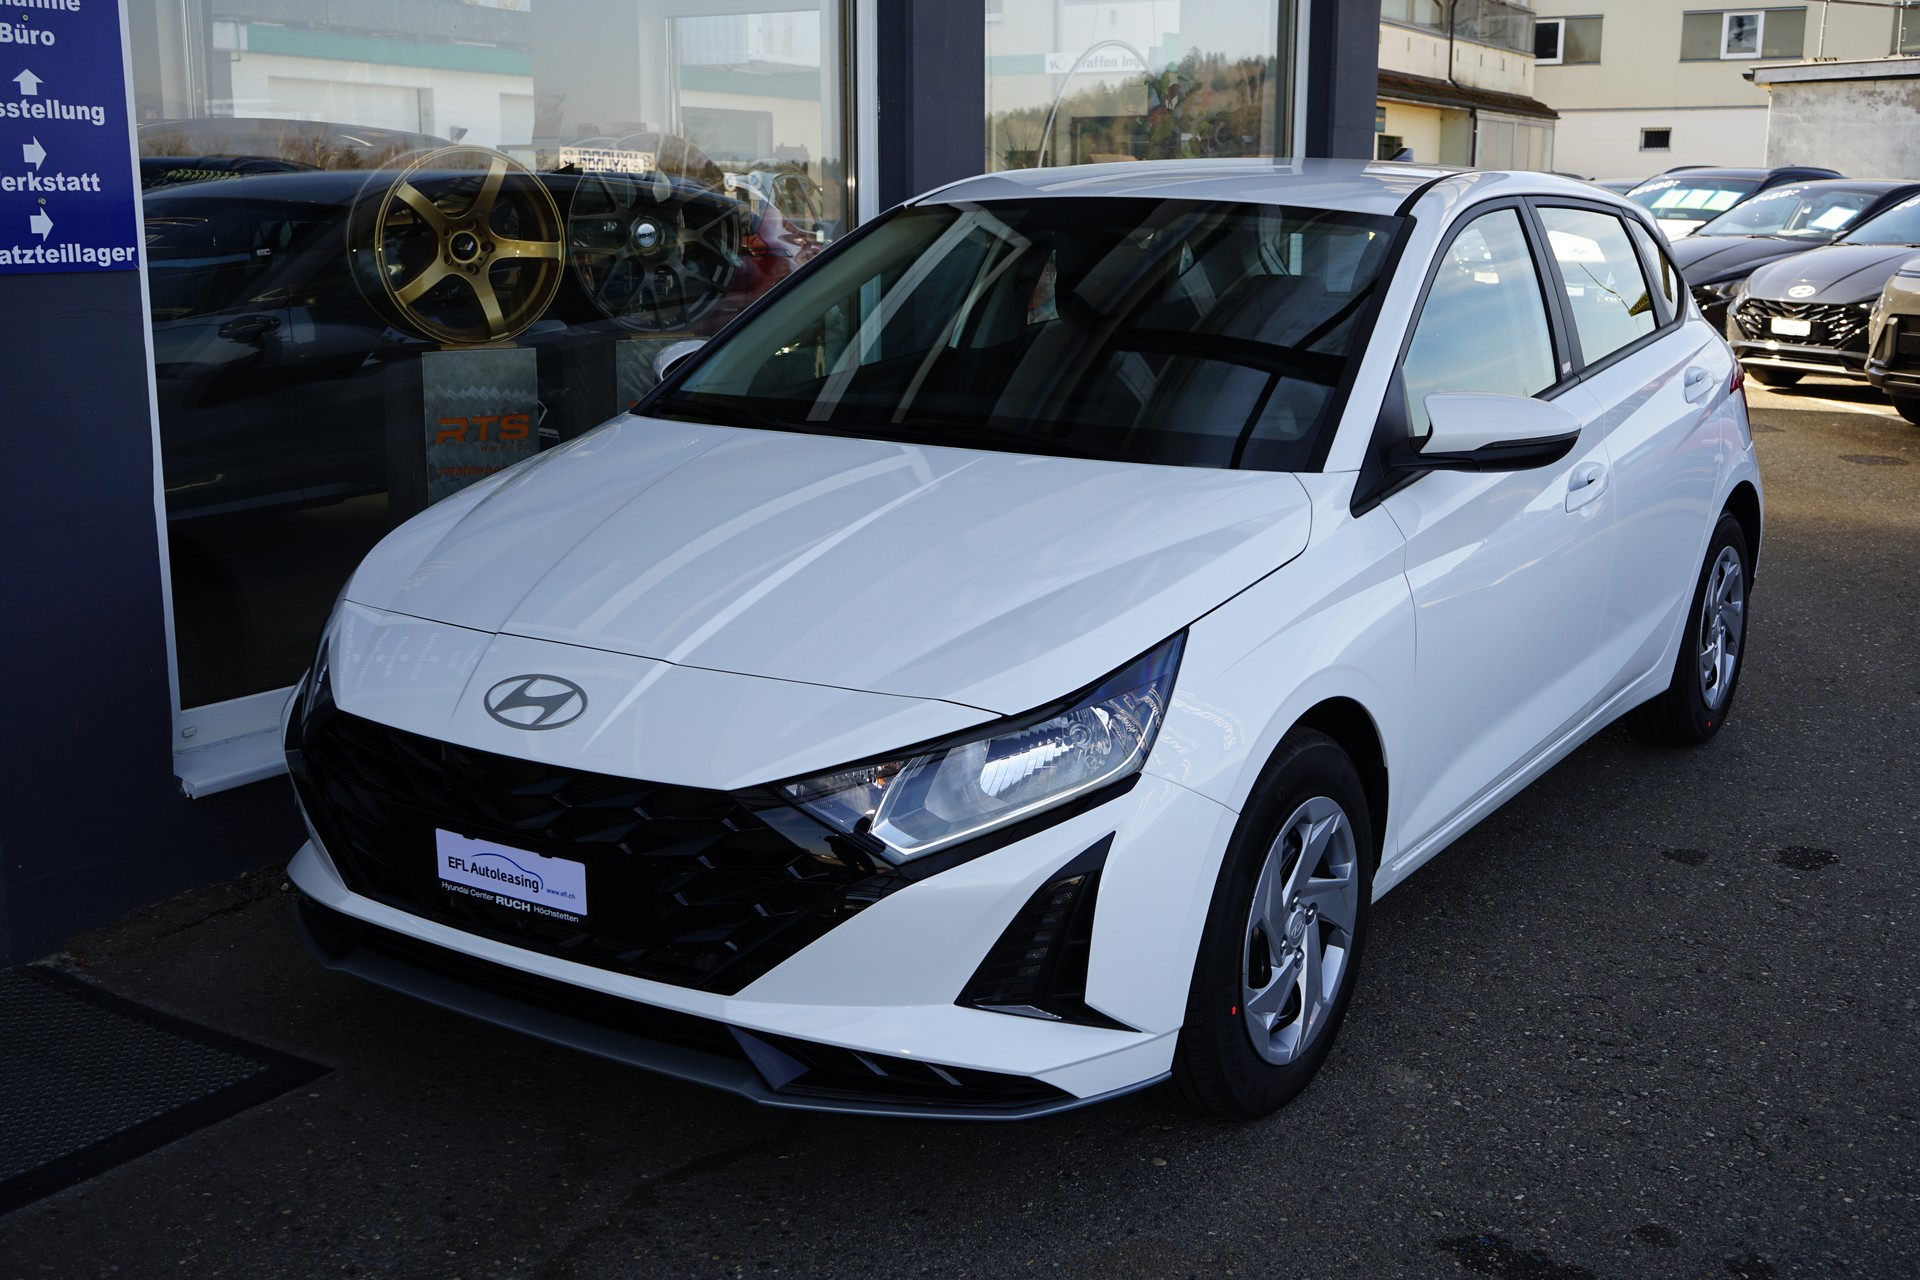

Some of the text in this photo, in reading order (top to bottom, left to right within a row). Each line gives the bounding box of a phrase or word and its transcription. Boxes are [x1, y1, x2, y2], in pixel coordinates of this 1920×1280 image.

[0, 22, 55, 46] Büro
[0, 171, 101, 192] erkstatt
[0, 243, 136, 267] atzteillager
[435, 413, 530, 445] RTS
[448, 856, 540, 893] EFL Autoleasing
[441, 881, 579, 923] Hyundai Center RUCH Höchstetten
[546, 887, 576, 900] www.efl.ch
